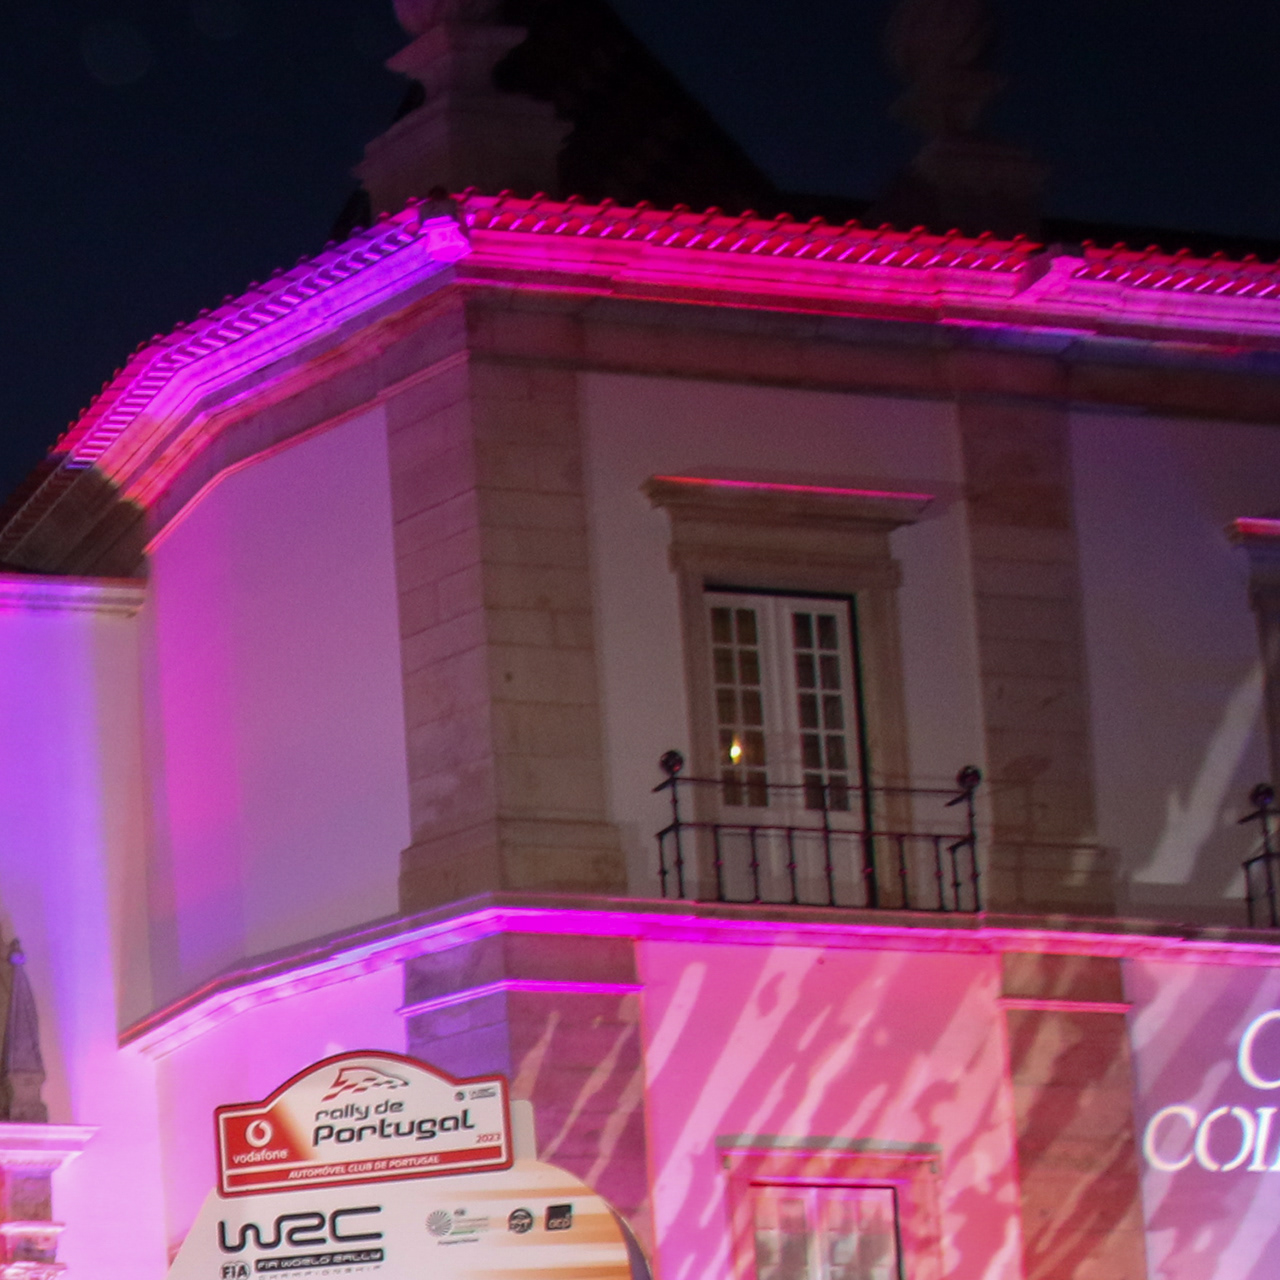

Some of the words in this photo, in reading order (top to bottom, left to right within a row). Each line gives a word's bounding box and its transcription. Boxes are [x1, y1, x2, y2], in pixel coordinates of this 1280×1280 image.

[315, 1103, 369, 1122] rally
[374, 1100, 405, 1115] de
[312, 1109, 475, 1147] Portugal
[476, 1133, 501, 1144] 2023
[1143, 1104, 1280, 1172] COI
[232, 1148, 288, 1164] vodafone
[347, 1163, 373, 1174] CLUB
[375, 1161, 388, 1171] DE
[389, 1155, 439, 1169] PORTUGAL
[217, 1205, 383, 1254] WRC
